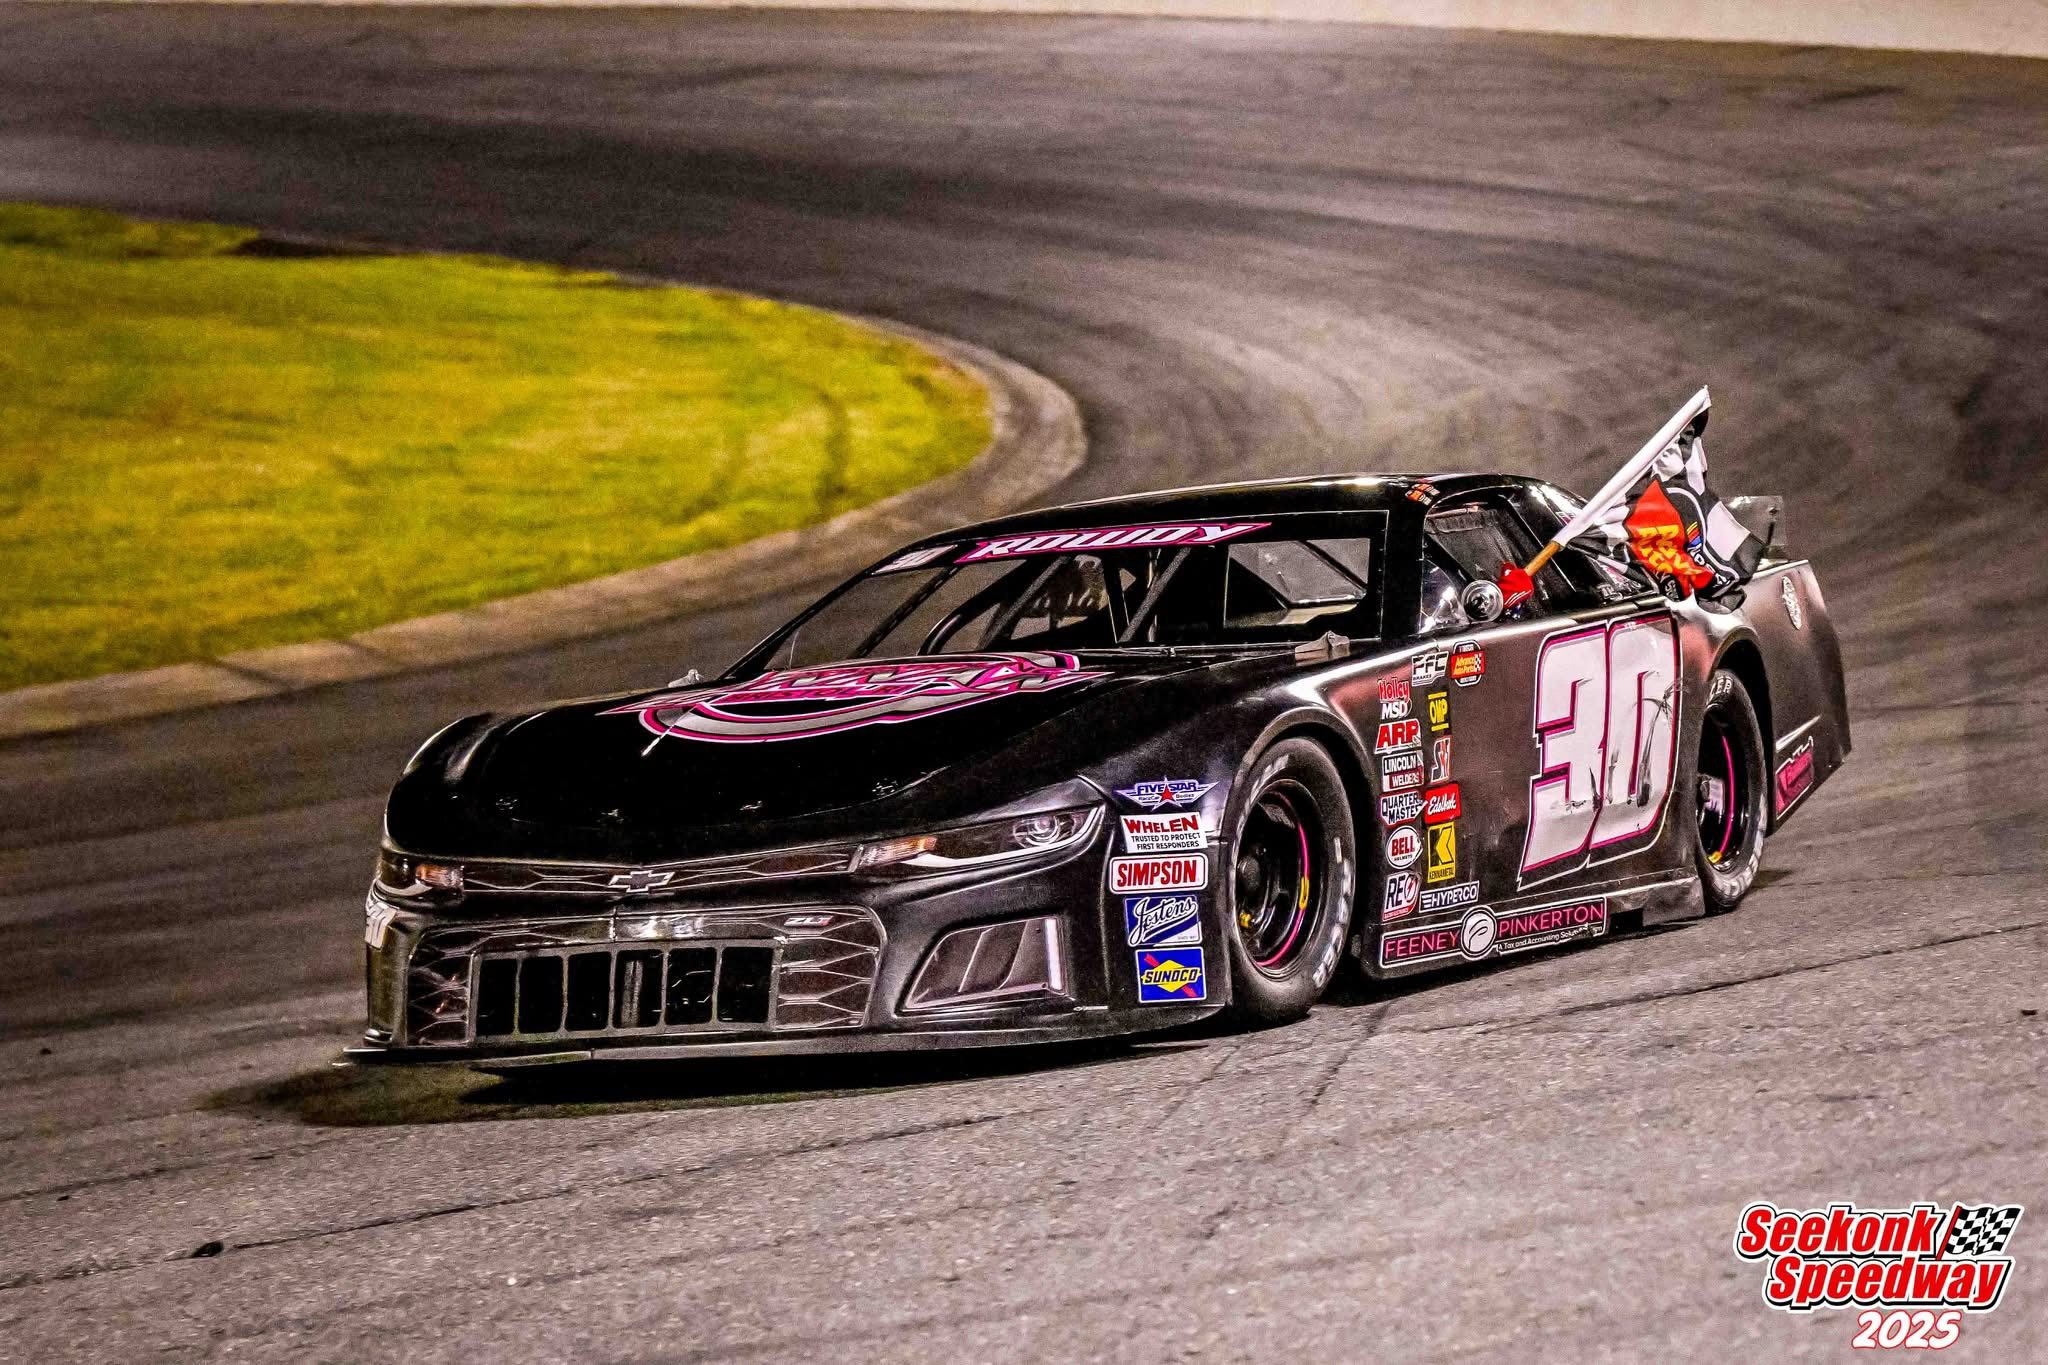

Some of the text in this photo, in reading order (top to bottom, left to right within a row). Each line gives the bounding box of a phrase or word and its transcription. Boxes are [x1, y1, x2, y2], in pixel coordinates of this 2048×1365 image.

[963, 524, 1259, 559] ROWDY
[1413, 652, 1447, 675] PFC
[1382, 701, 1408, 719] MSD
[1429, 699, 1448, 724] OMP
[1376, 720, 1418, 748] ARP
[1521, 612, 1681, 881] 30
[1385, 755, 1417, 774] LINCOLN
[1137, 782, 1197, 795] FIVE STAR
[1382, 792, 1420, 816] QUARTER
[1123, 815, 1199, 833] WHELEN
[1131, 832, 1200, 842] TRUSTED TO PROTECT
[1156, 841, 1199, 849] RESPONDERS
[1391, 836, 1415, 857] BELL
[1117, 860, 1197, 887] SIMPSON
[1431, 885, 1477, 908] HYPERCO
[1130, 897, 1197, 945] Jostens
[1499, 903, 1604, 937] PINKERTON
[1385, 930, 1460, 958] FEENEY
[1504, 942, 1515, 950] Tax
[1515, 939, 1527, 947] and
[1527, 932, 1560, 946] Accounting
[1145, 968, 1198, 984] SUNOCO
